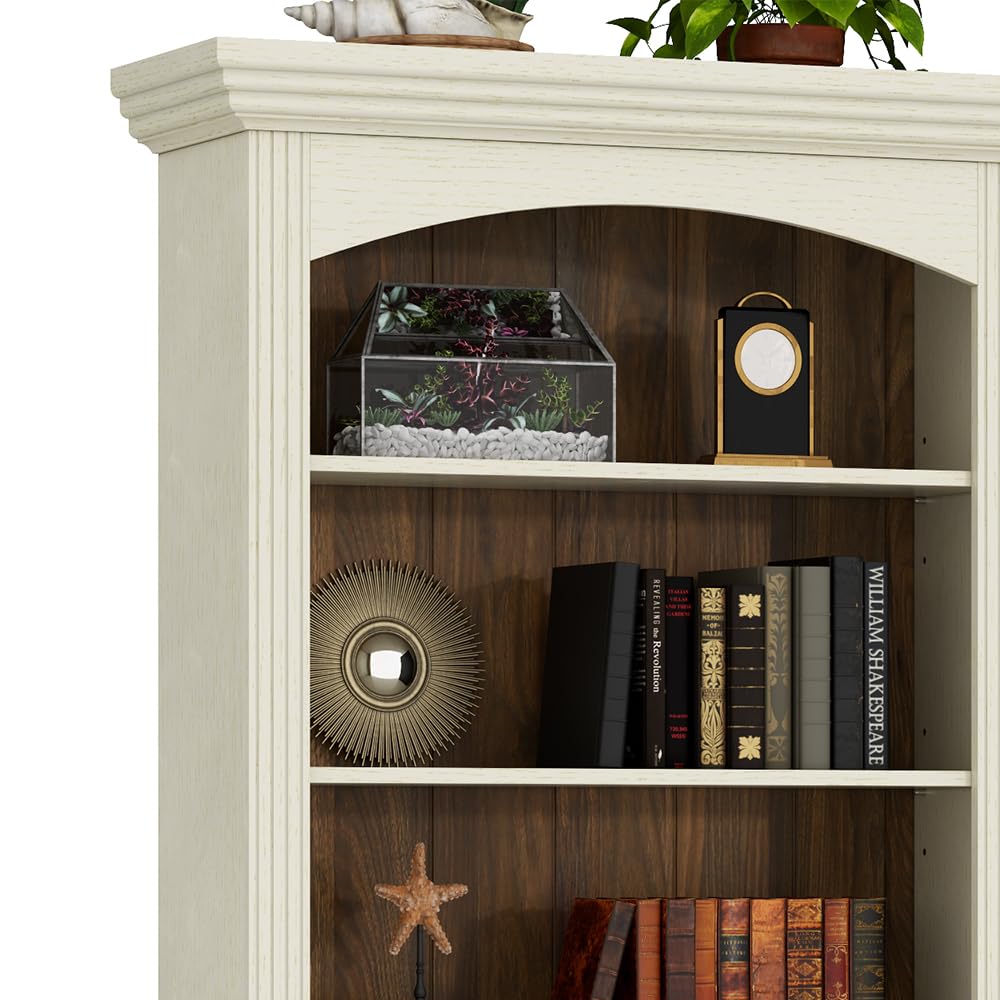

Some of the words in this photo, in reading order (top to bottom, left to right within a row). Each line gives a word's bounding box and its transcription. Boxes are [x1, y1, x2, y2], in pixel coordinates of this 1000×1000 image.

[653, 578, 661, 626] REVEALING
[868, 566, 885, 644] WILLIAM
[652, 640, 662, 693] Revolution
[868, 648, 885, 766] SHAKESPEARE
